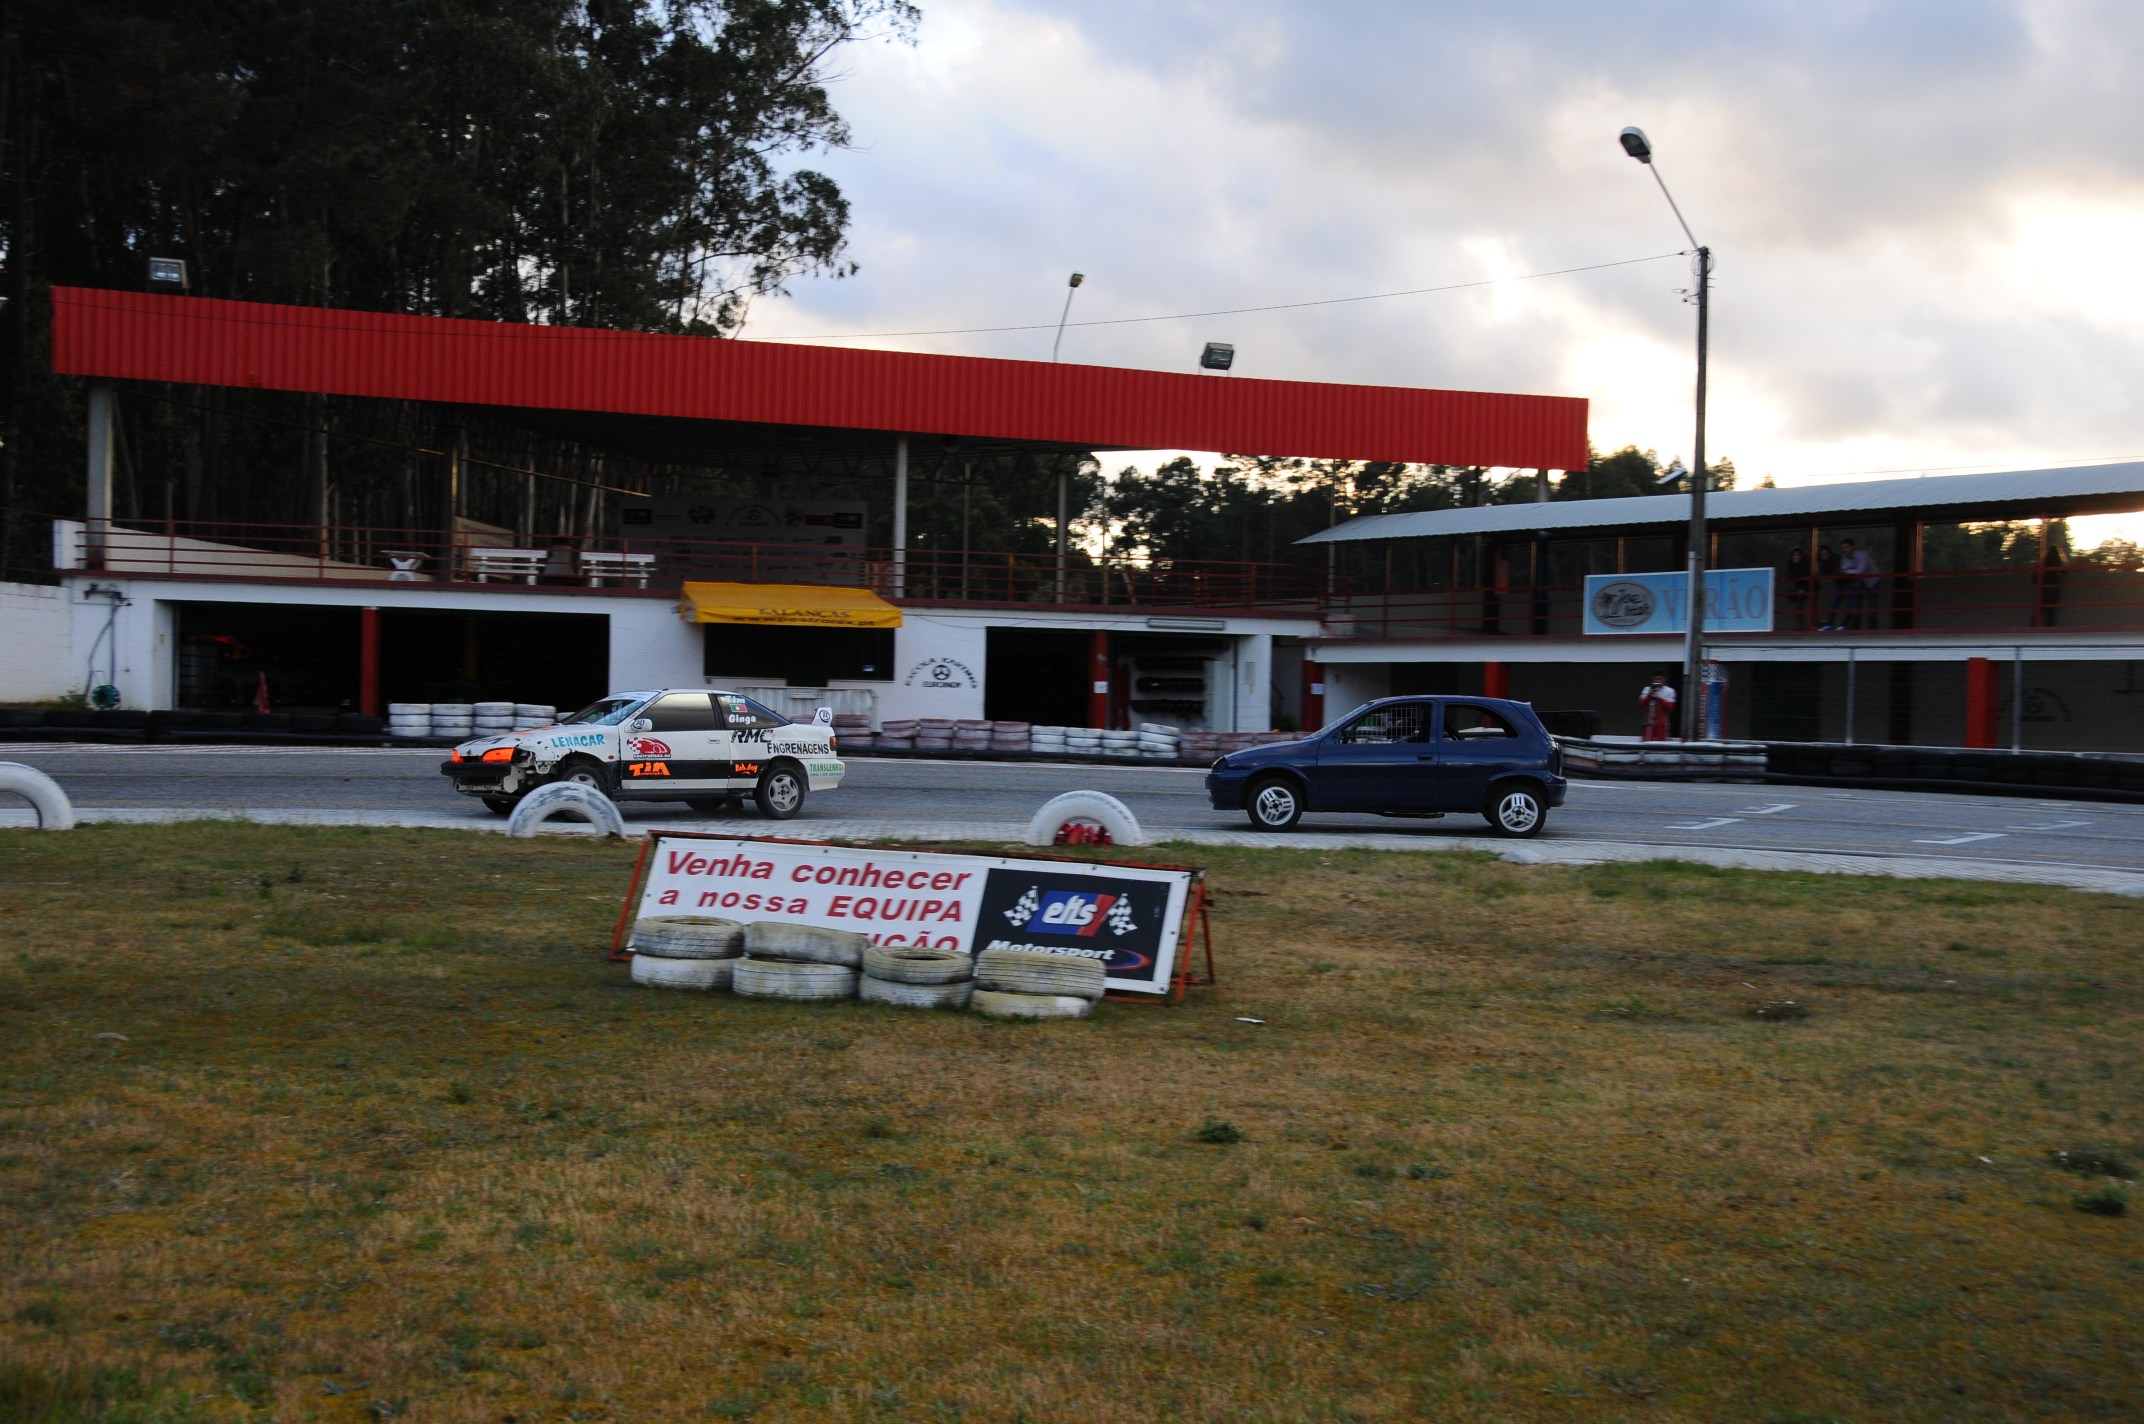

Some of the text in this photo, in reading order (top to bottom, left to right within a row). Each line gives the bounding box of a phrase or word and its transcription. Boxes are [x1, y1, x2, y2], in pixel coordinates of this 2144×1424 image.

[728, 714, 757, 725] Ginga
[551, 733, 605, 748] LENACAR
[731, 729, 774, 743] RMC
[767, 742, 829, 754] ENGRENAGENS
[668, 850, 973, 891] Venha conhecer
[659, 889, 962, 922] a nossa EQUIPA
[985, 939, 1116, 960] Motorsport
